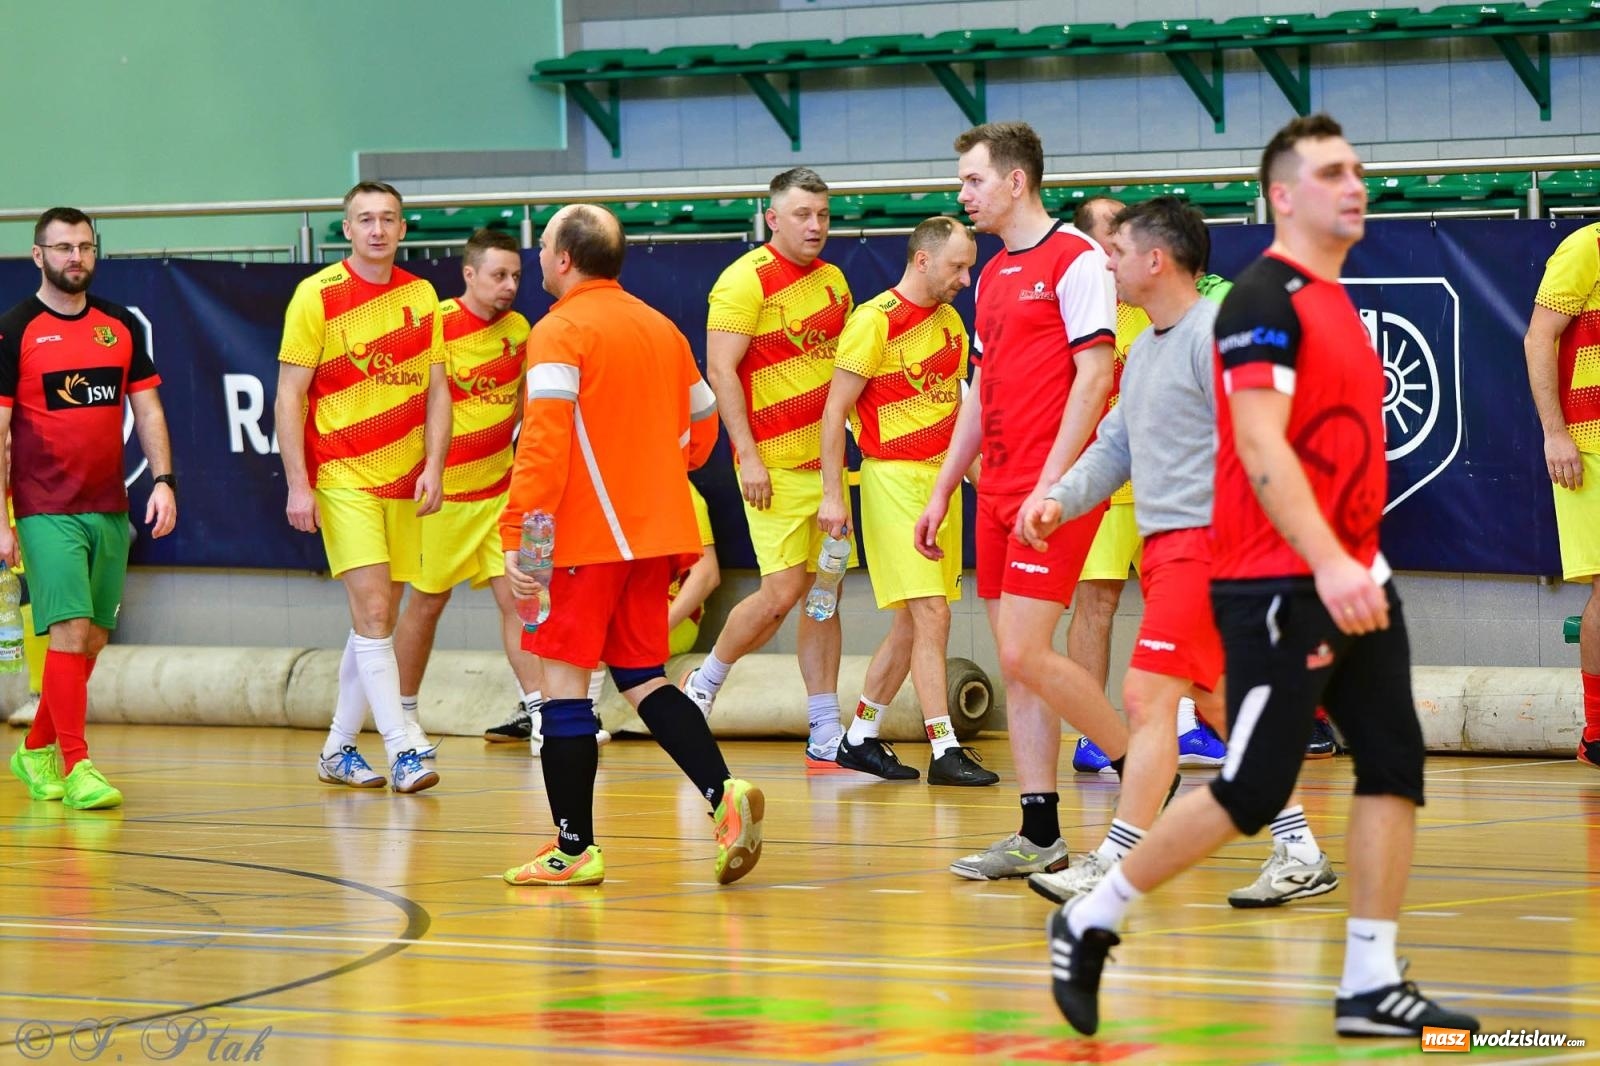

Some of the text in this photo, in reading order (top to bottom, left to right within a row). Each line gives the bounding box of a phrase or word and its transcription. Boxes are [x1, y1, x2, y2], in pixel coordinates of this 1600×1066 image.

[375, 370, 424, 387] HOLIDAY
[87, 385, 116, 404] JSW
[1011, 560, 1049, 574] regio
[1139, 638, 1176, 652] regio
